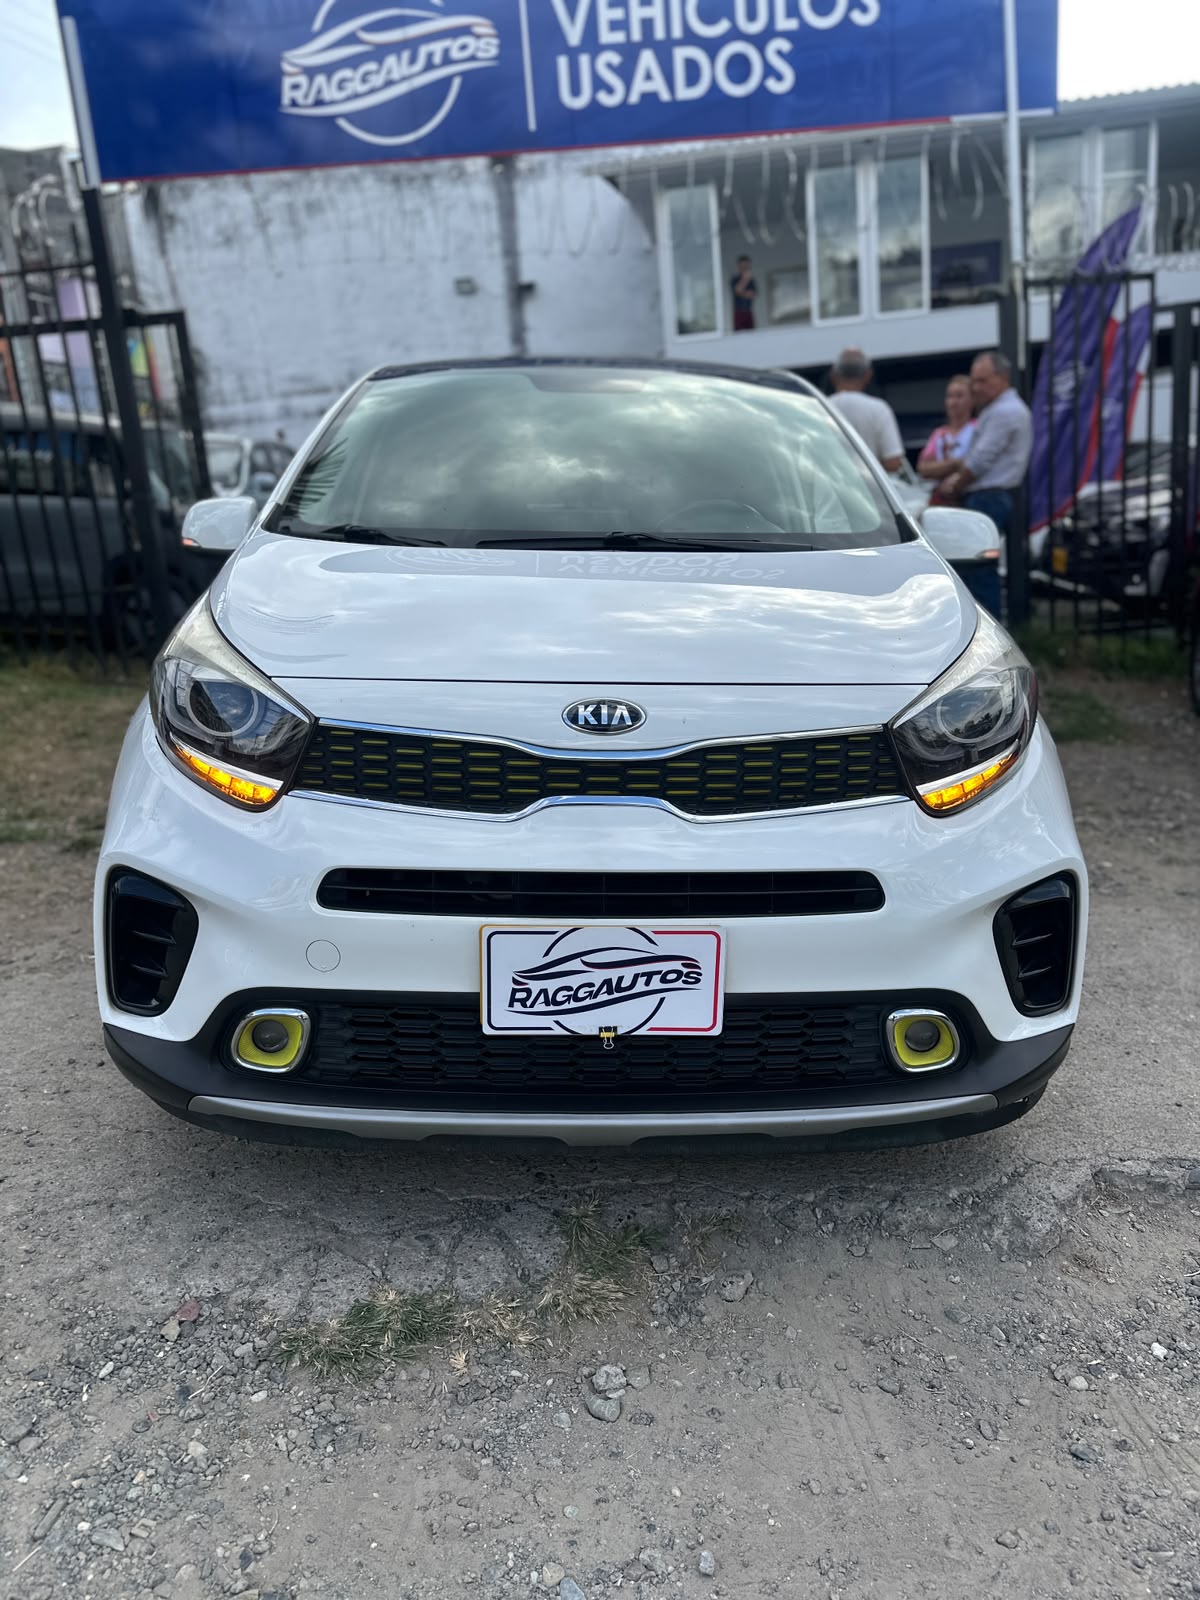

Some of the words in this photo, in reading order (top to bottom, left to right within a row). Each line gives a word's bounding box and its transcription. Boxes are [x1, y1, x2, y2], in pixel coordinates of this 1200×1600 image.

[281, 35, 499, 106] RAGGAUTOS
[556, 37, 796, 110] USADOS
[577, 704, 632, 725] KIA
[508, 969, 703, 1009] RAGGAUTOS
